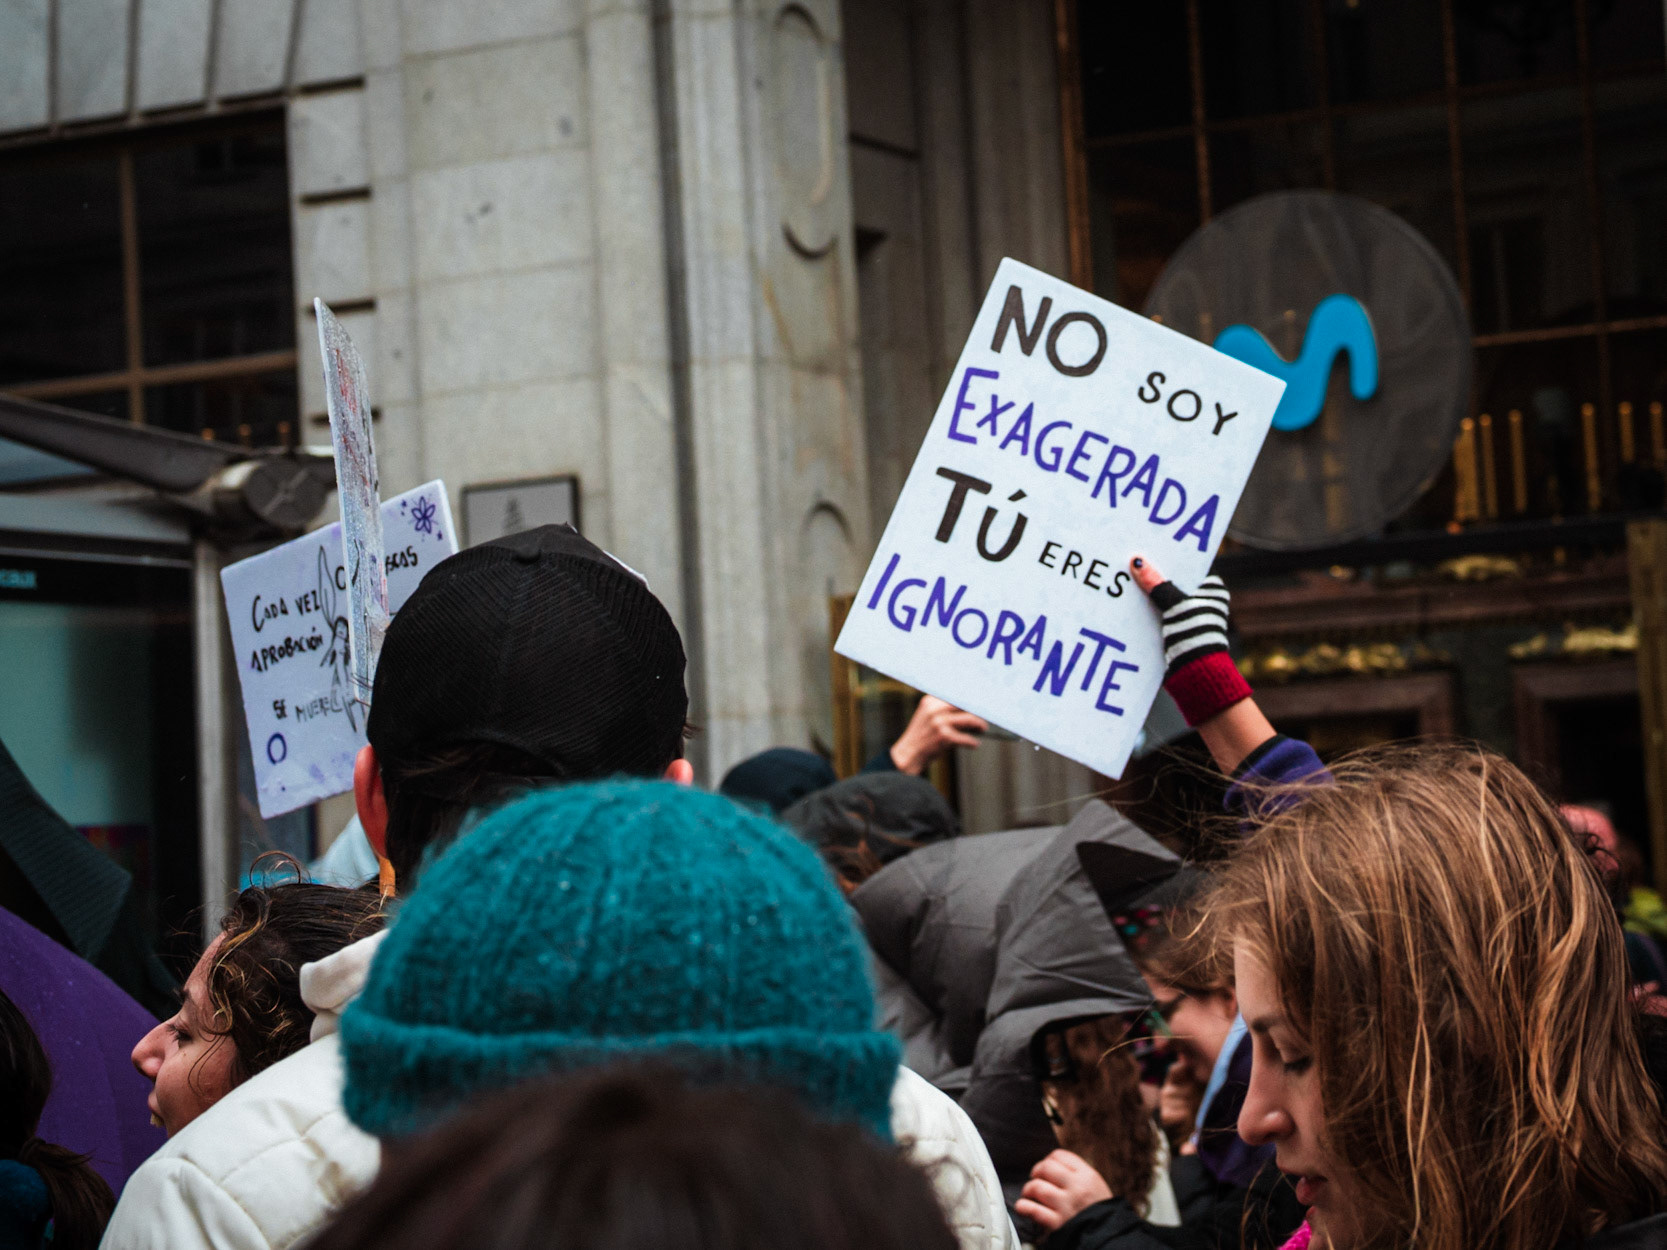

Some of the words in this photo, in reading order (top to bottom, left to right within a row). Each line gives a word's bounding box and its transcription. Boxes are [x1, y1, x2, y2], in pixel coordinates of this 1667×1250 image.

[990, 285, 1108, 377] NO
[1138, 371, 1238, 436] SOY
[935, 466, 1029, 562] TÚ
[1039, 542, 1131, 598] ERES
[947, 367, 1220, 552] EXAGERADA
[295, 589, 320, 616] VEZ
[867, 553, 1140, 716] IGNORANTE
